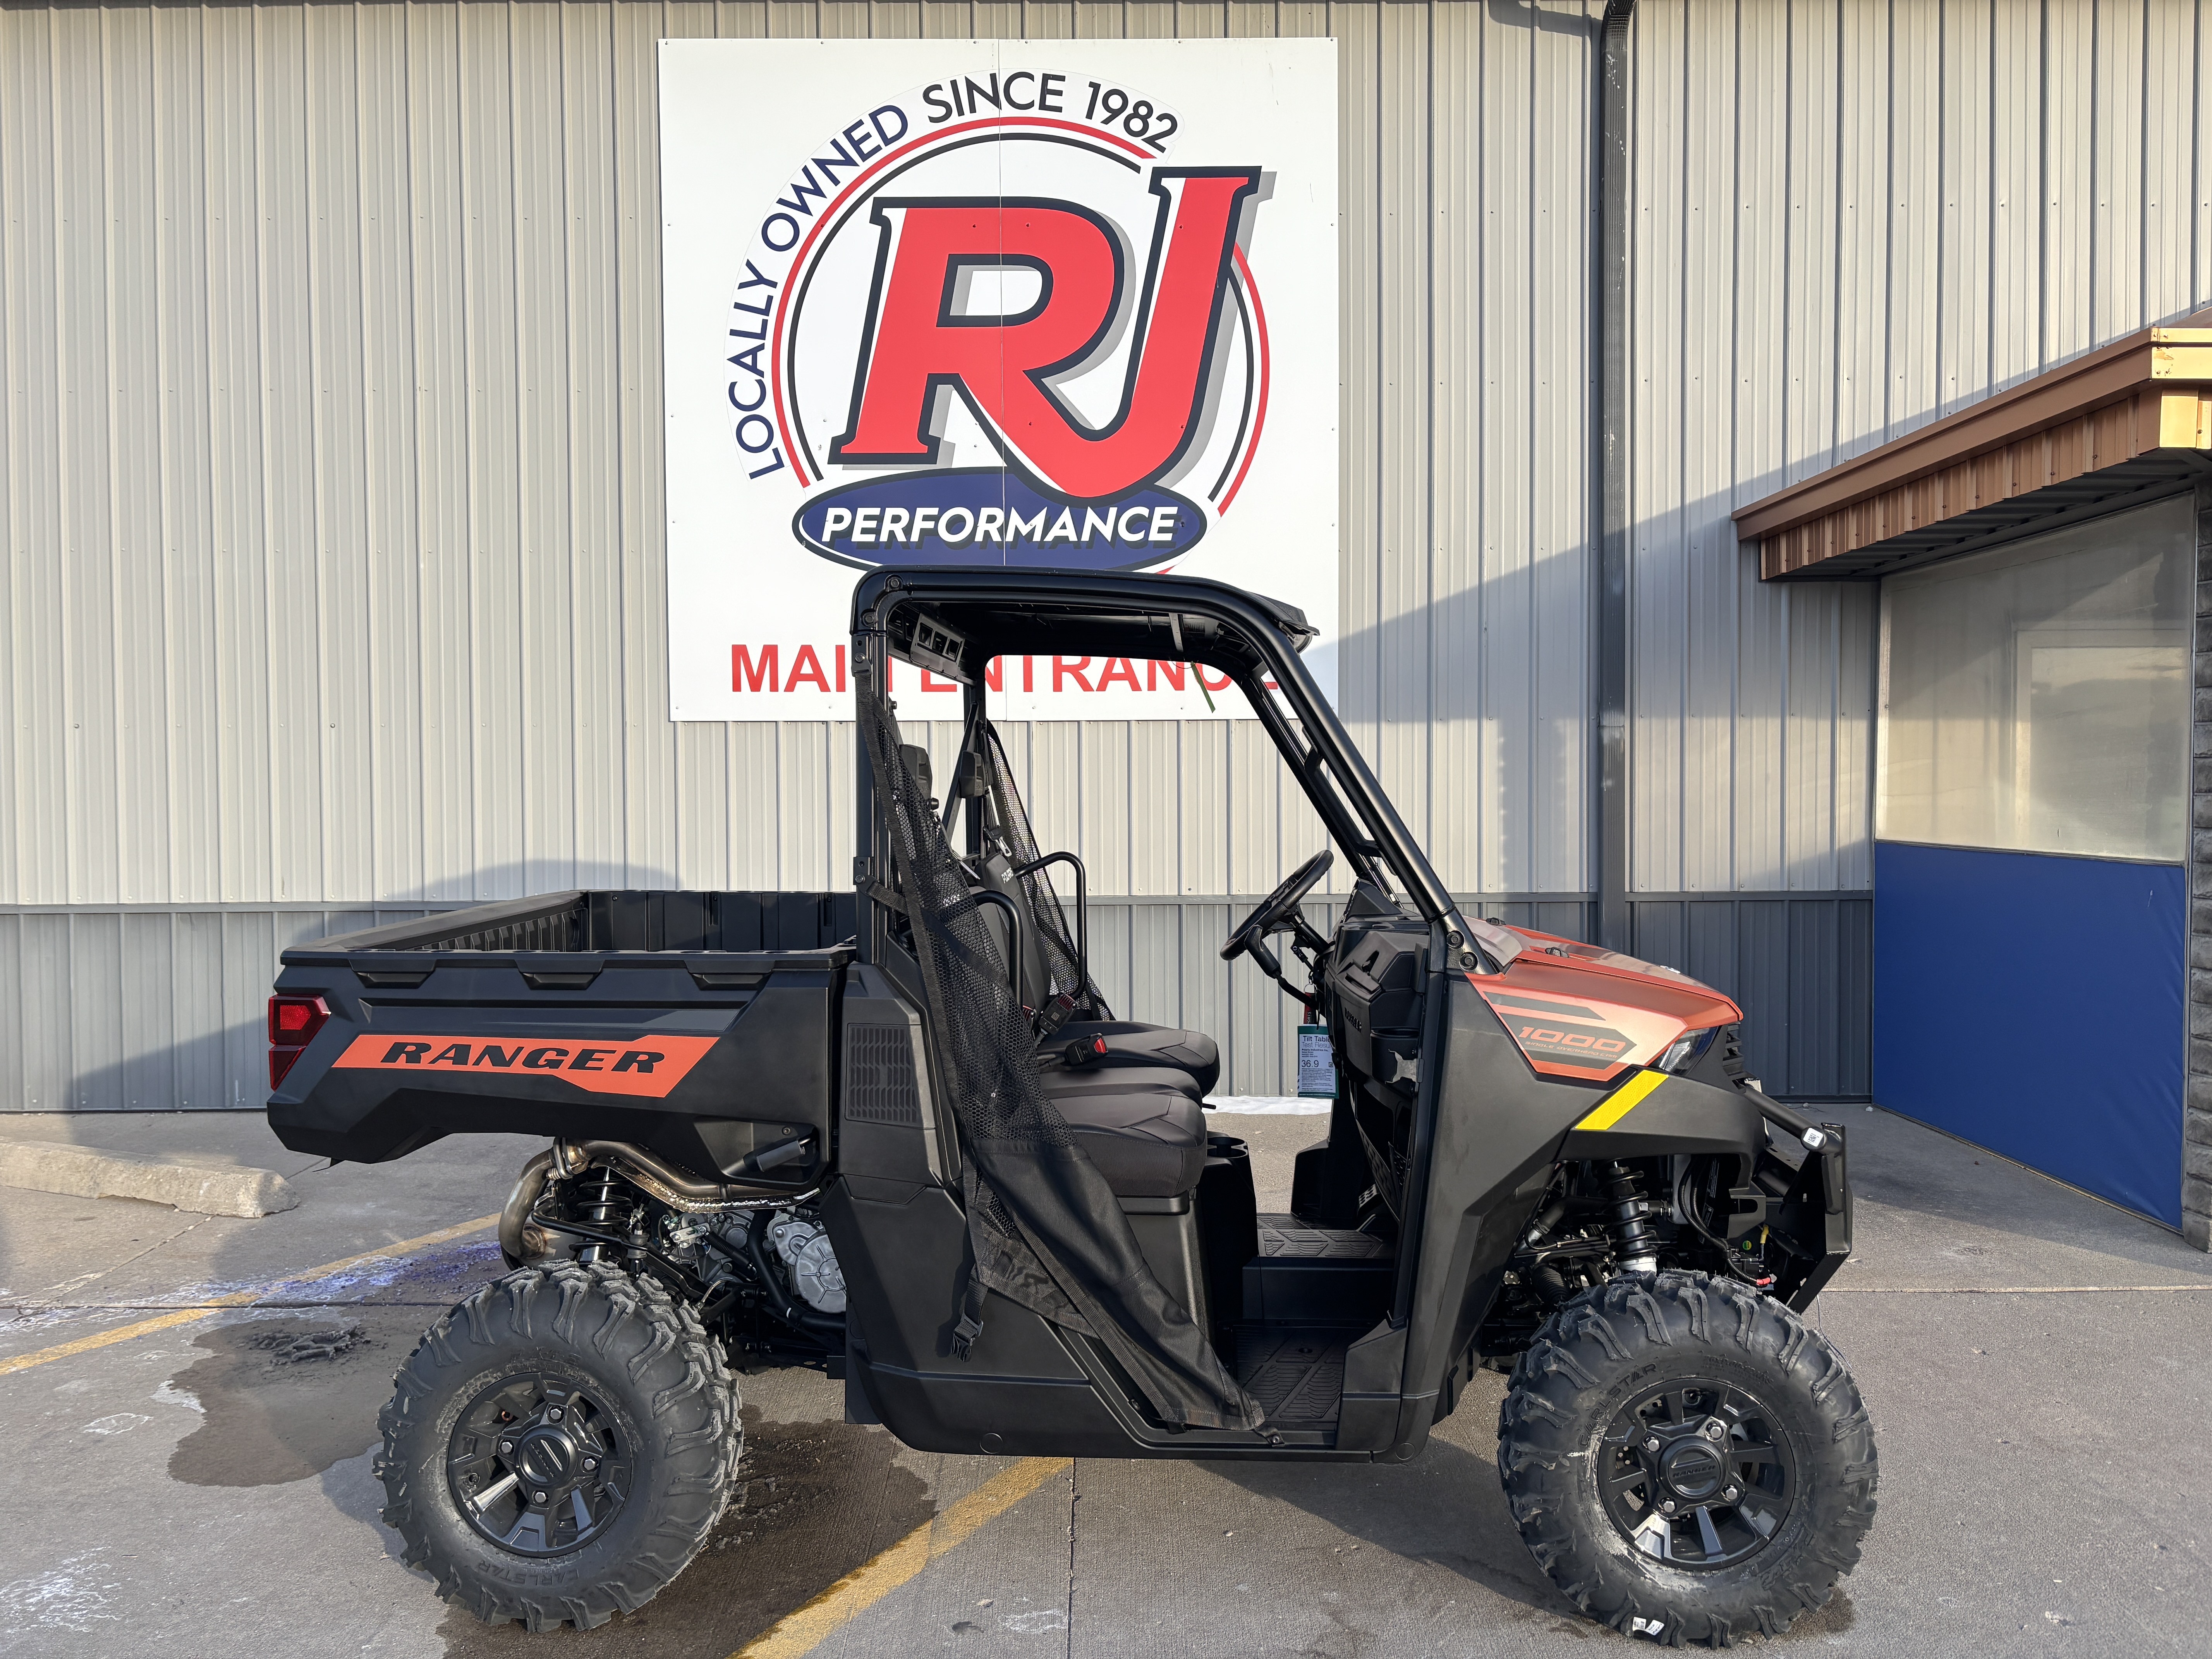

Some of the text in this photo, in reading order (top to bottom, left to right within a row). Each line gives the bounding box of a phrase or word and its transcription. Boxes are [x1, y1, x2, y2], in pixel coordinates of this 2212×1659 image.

[726, 71, 1178, 480] LOCALLY OWNED SINCE 1982
[828, 166, 1262, 498] RJ
[822, 506, 1178, 542] PERFORMANCE
[732, 644, 893, 692] MAI
[1519, 1026, 1626, 1052] 1000
[1557, 1046, 1599, 1056] OVERHEAD
[380, 1042, 665, 1073] RANGER
[1302, 1060, 1319, 1068] 36.9
[1578, 1362, 1657, 1447] CARLSTAR
